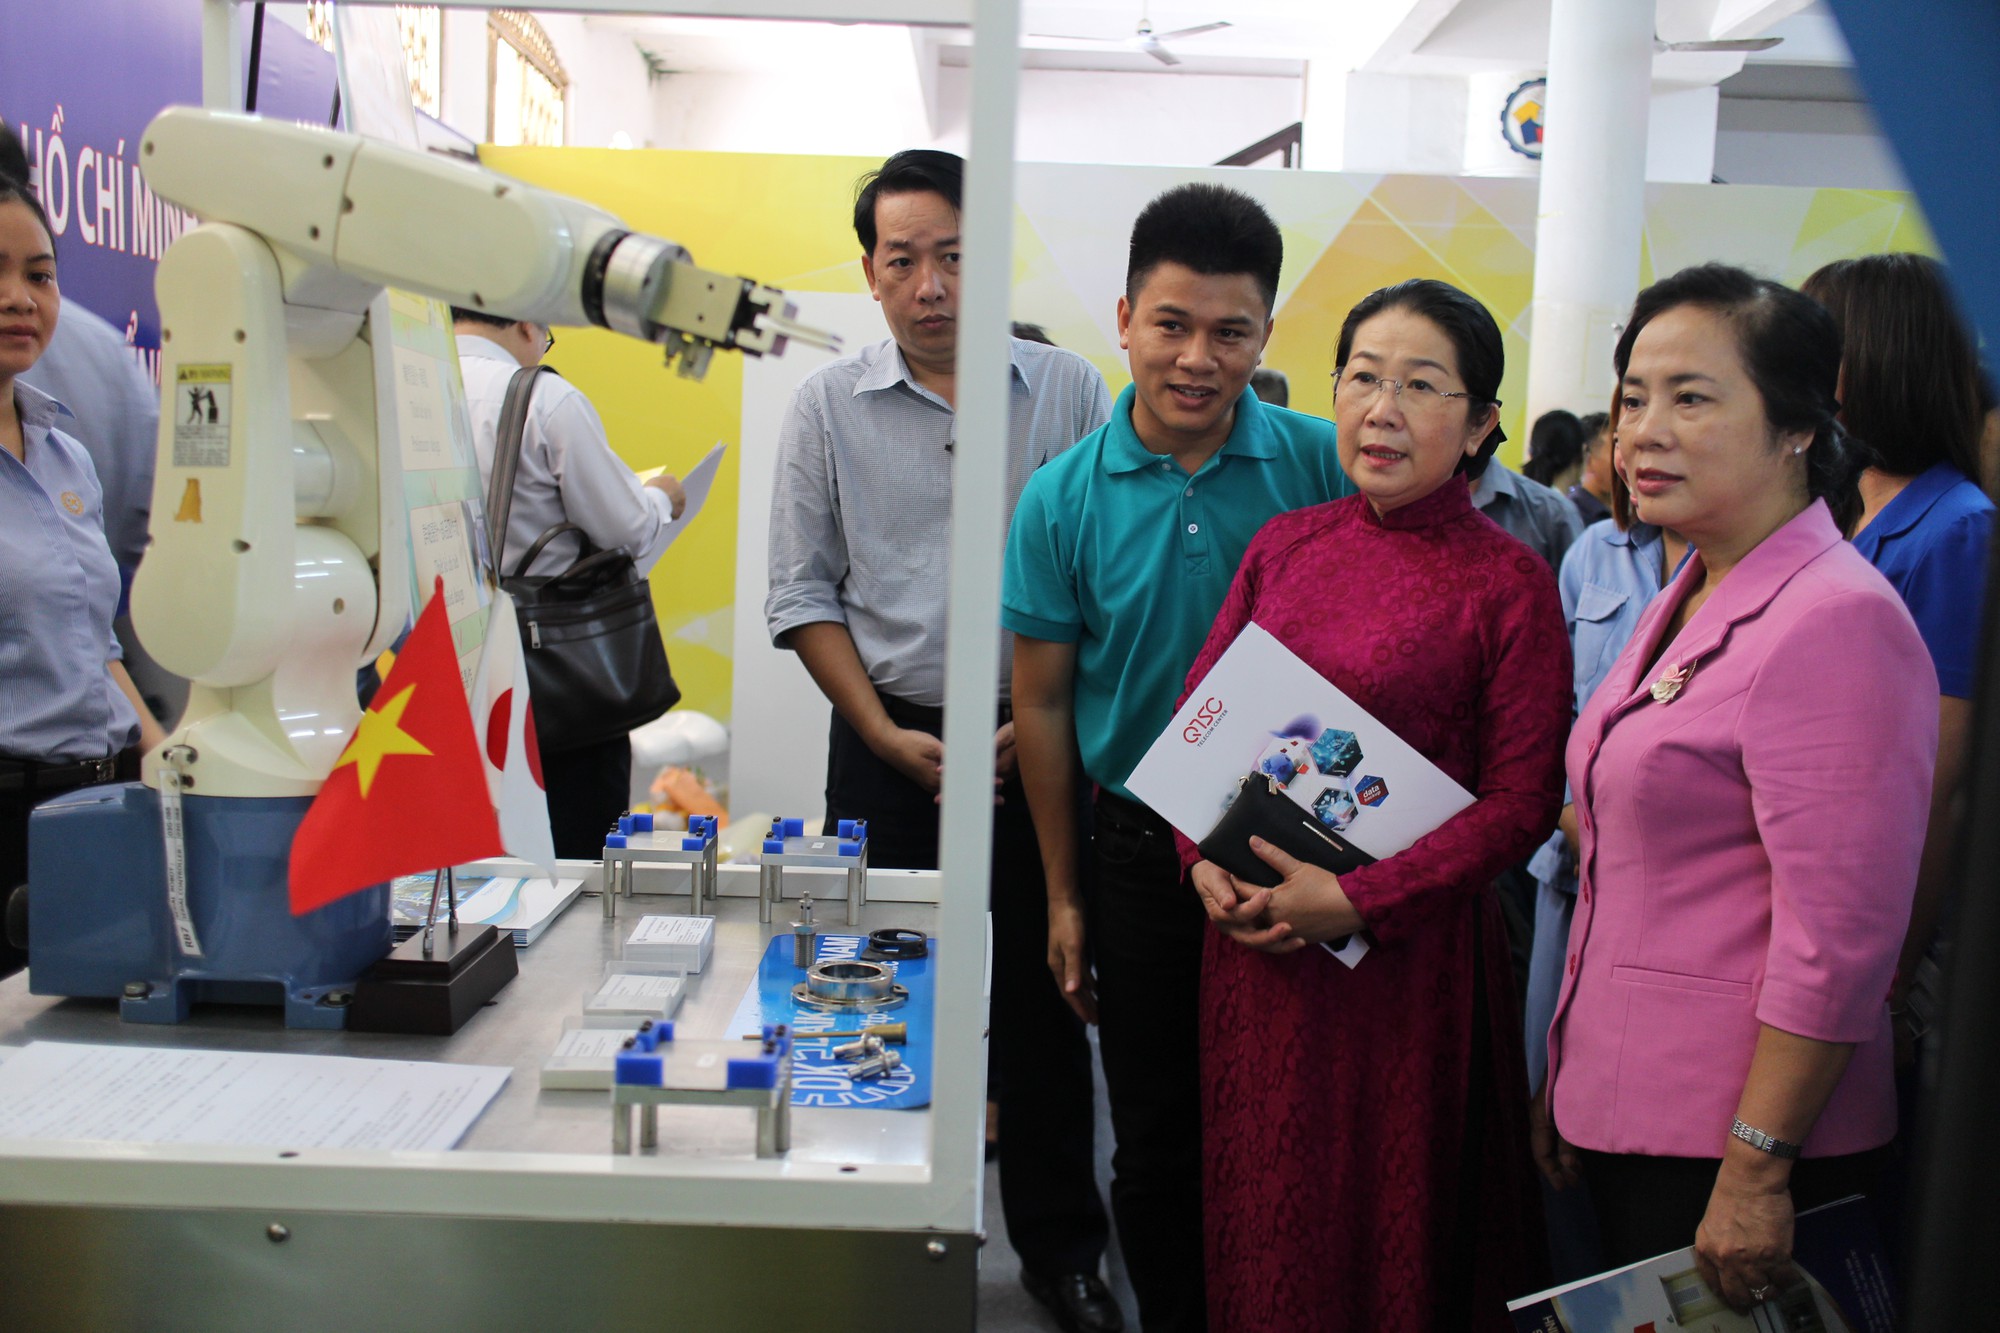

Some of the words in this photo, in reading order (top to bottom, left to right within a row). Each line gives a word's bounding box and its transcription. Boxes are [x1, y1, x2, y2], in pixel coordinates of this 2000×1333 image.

[76, 138, 126, 252] CHÍ
[1197, 727, 1215, 748] TELECOM
[1213, 709, 1228, 728] CENTER
[1363, 785, 1380, 798] data
[180, 926, 194, 949] RB7
